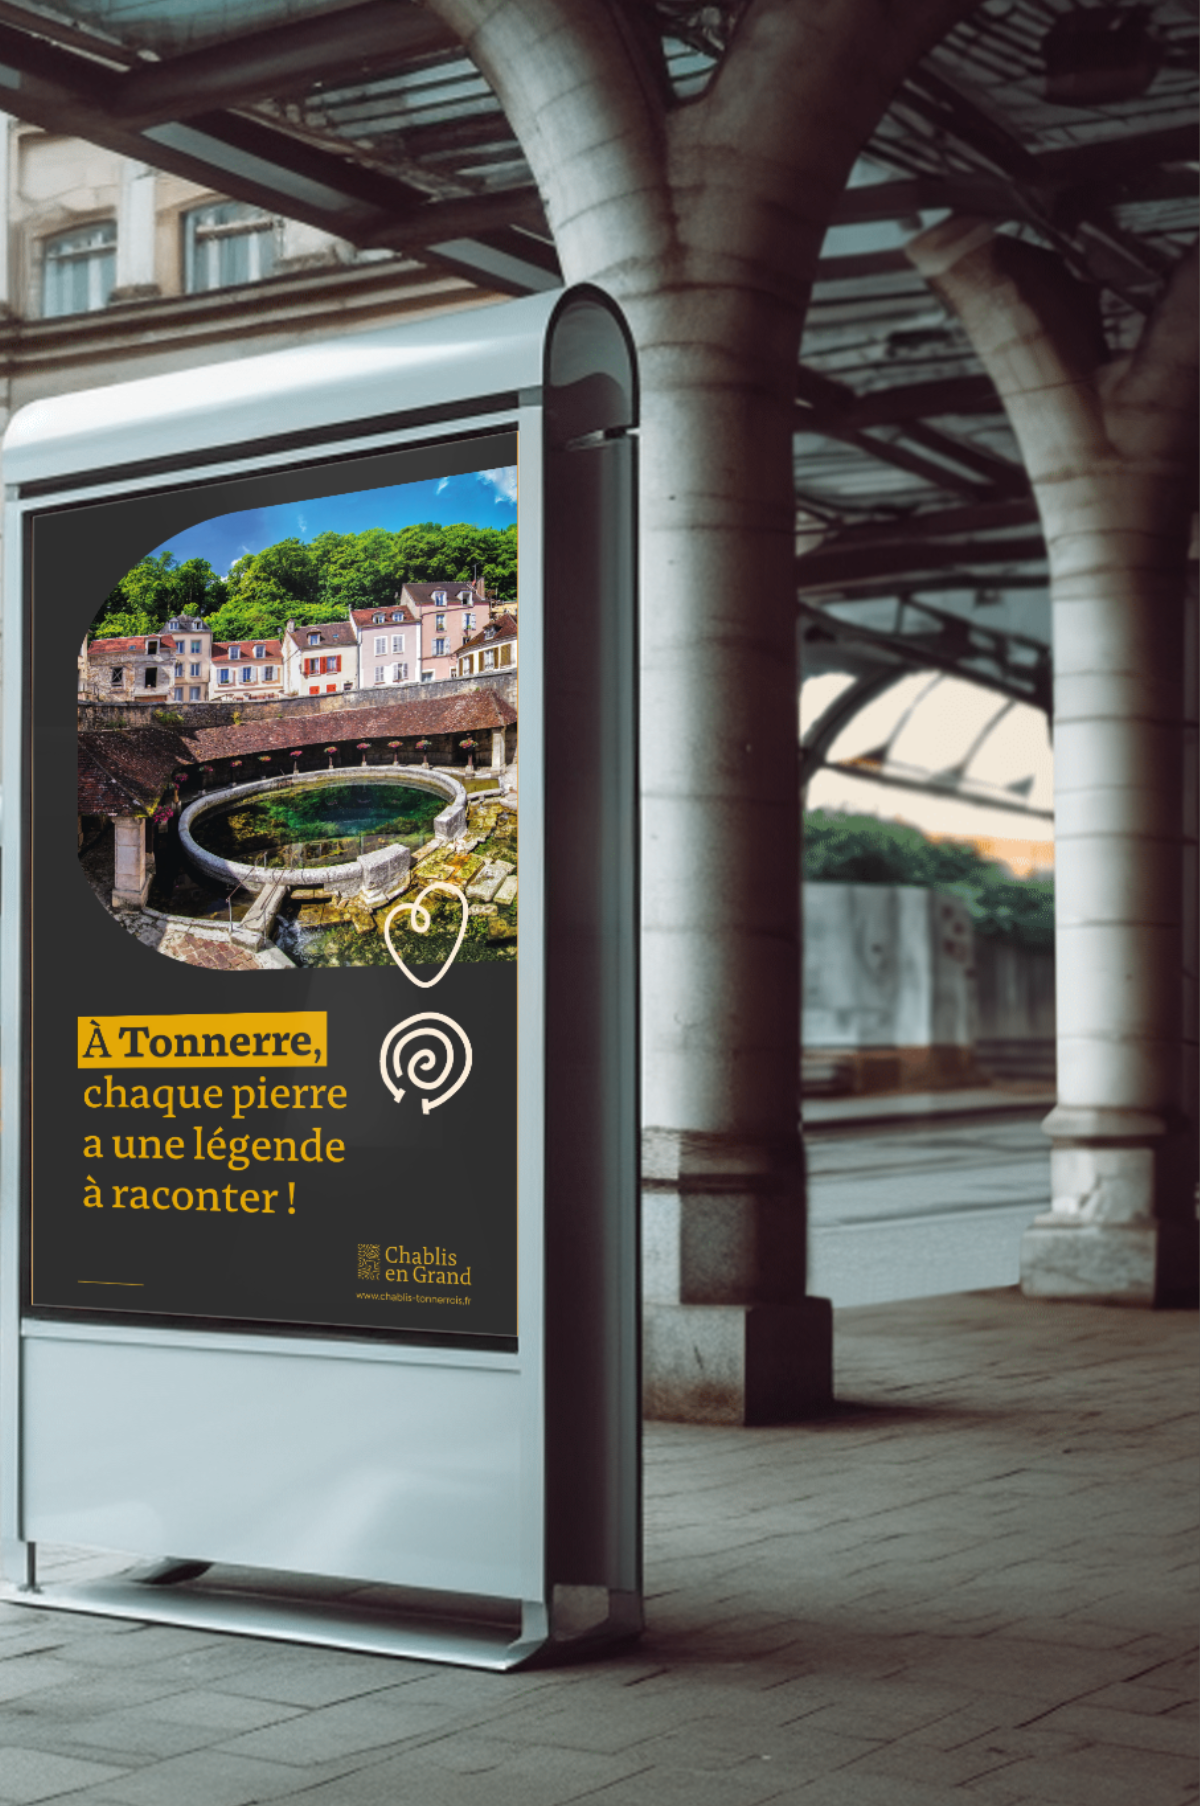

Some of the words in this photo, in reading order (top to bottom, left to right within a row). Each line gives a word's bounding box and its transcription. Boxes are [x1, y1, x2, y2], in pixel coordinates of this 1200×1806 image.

[82, 1019, 112, 1058] À
[118, 1026, 322, 1064] Tonnerre,
[83, 1074, 224, 1119] chaque
[231, 1075, 348, 1120] pierre
[82, 1134, 104, 1159] a
[111, 1135, 185, 1160] une
[192, 1125, 346, 1171] légende
[82, 1174, 104, 1209] à
[111, 1182, 279, 1214] raconter
[385, 1245, 457, 1267] Chablis
[385, 1268, 409, 1282] en
[412, 1265, 472, 1286] Grand
[356, 1292, 471, 1305] www.chablis-tonnerrois.fr
